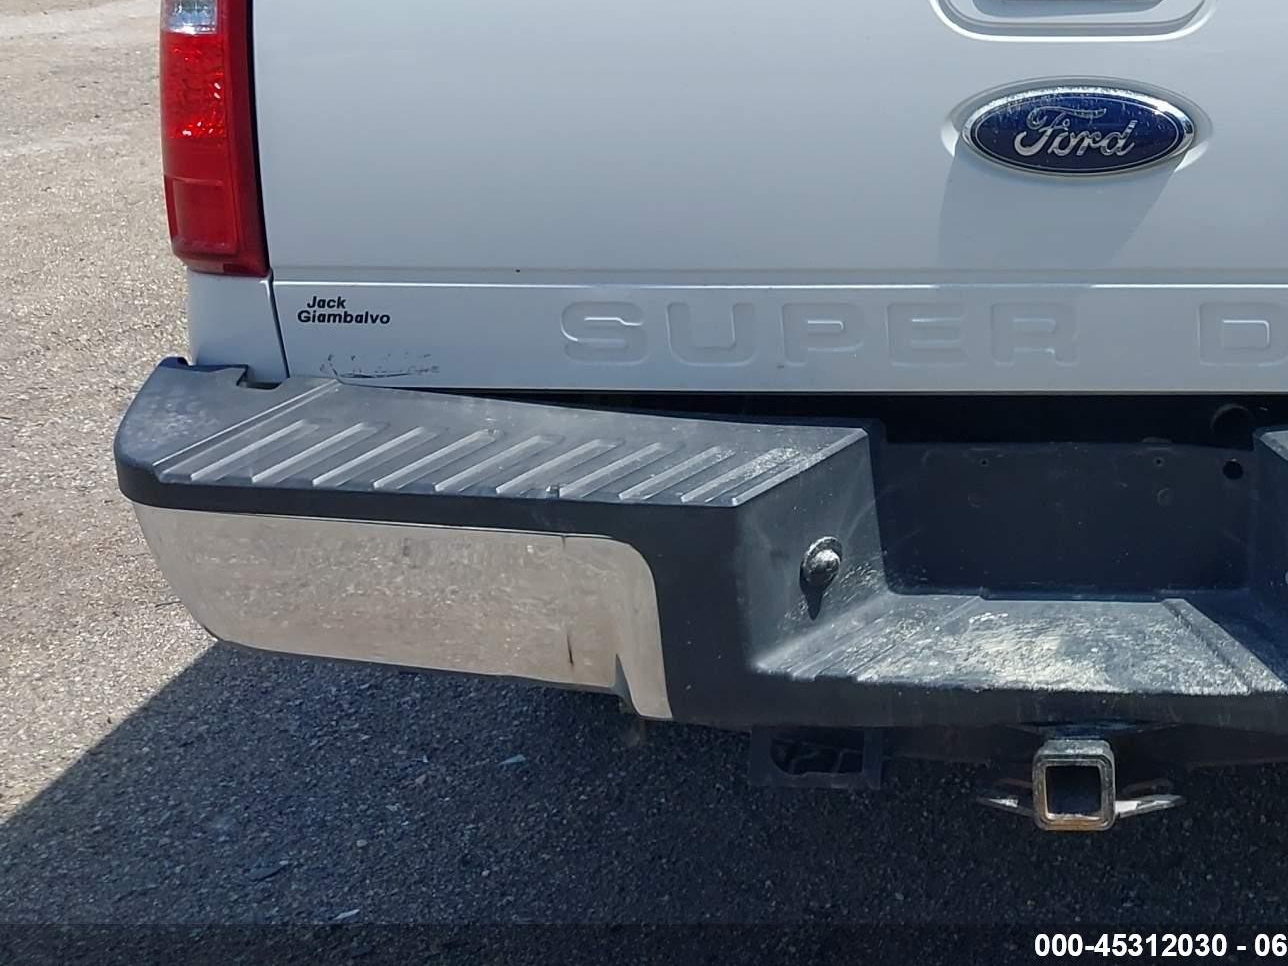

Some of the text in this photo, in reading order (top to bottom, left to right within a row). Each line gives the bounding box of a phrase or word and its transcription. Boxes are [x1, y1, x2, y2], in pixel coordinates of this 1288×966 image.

[1014, 105, 1138, 156] Ford
[297, 310, 391, 324] Giambalvo
[306, 296, 346, 309] Jack
[561, 301, 1080, 368] SUPER
